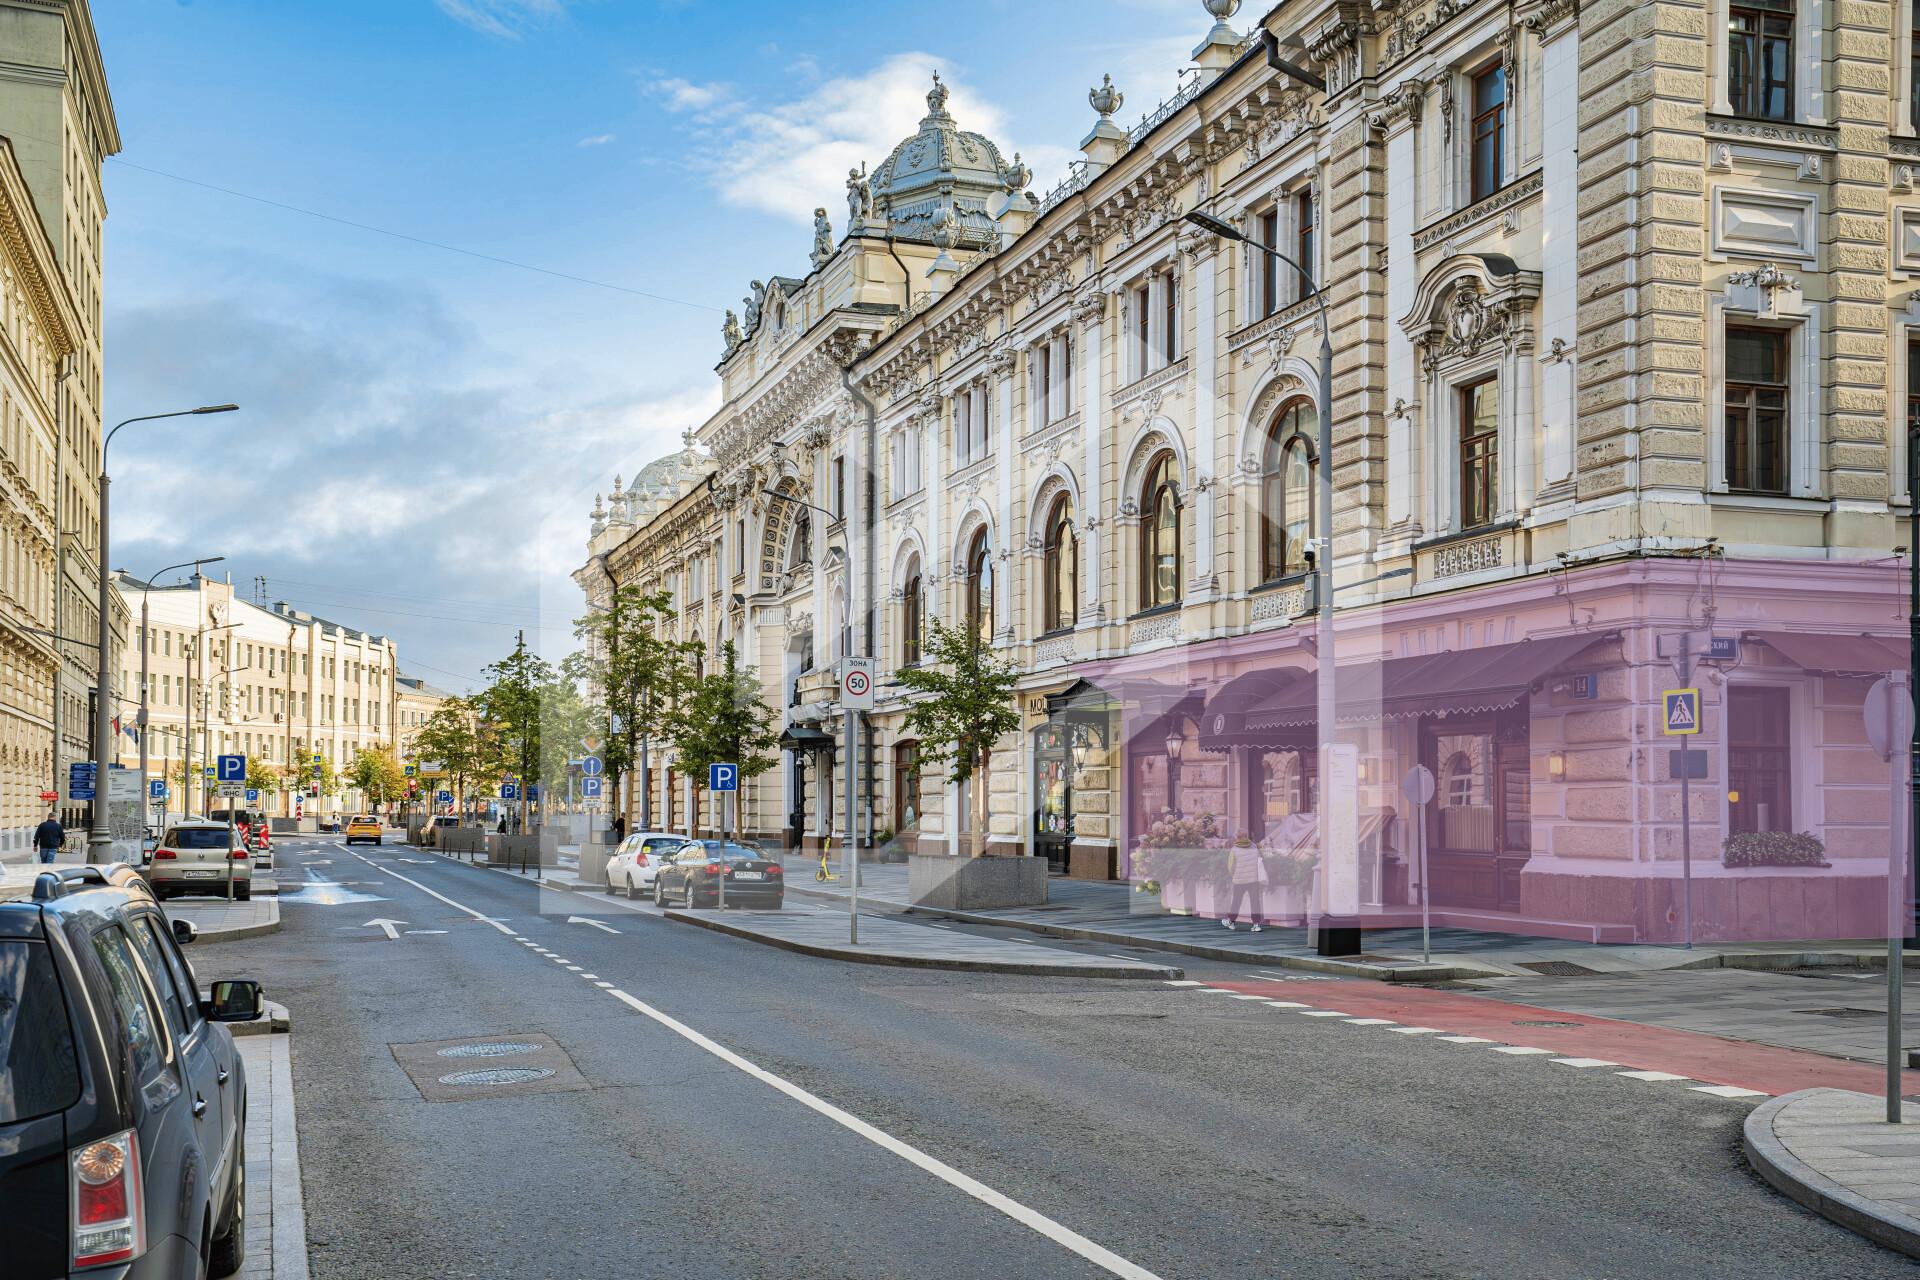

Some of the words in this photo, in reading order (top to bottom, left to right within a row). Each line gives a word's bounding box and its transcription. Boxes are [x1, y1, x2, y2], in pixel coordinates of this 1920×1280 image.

[851, 678, 864, 688] 50
[225, 757, 241, 779] P
[717, 766, 732, 789] P
[154, 782, 164, 795] P
[504, 786, 513, 797] P
[587, 779, 598, 795] P
[249, 790, 256, 800] P
[441, 791, 448, 800] P
